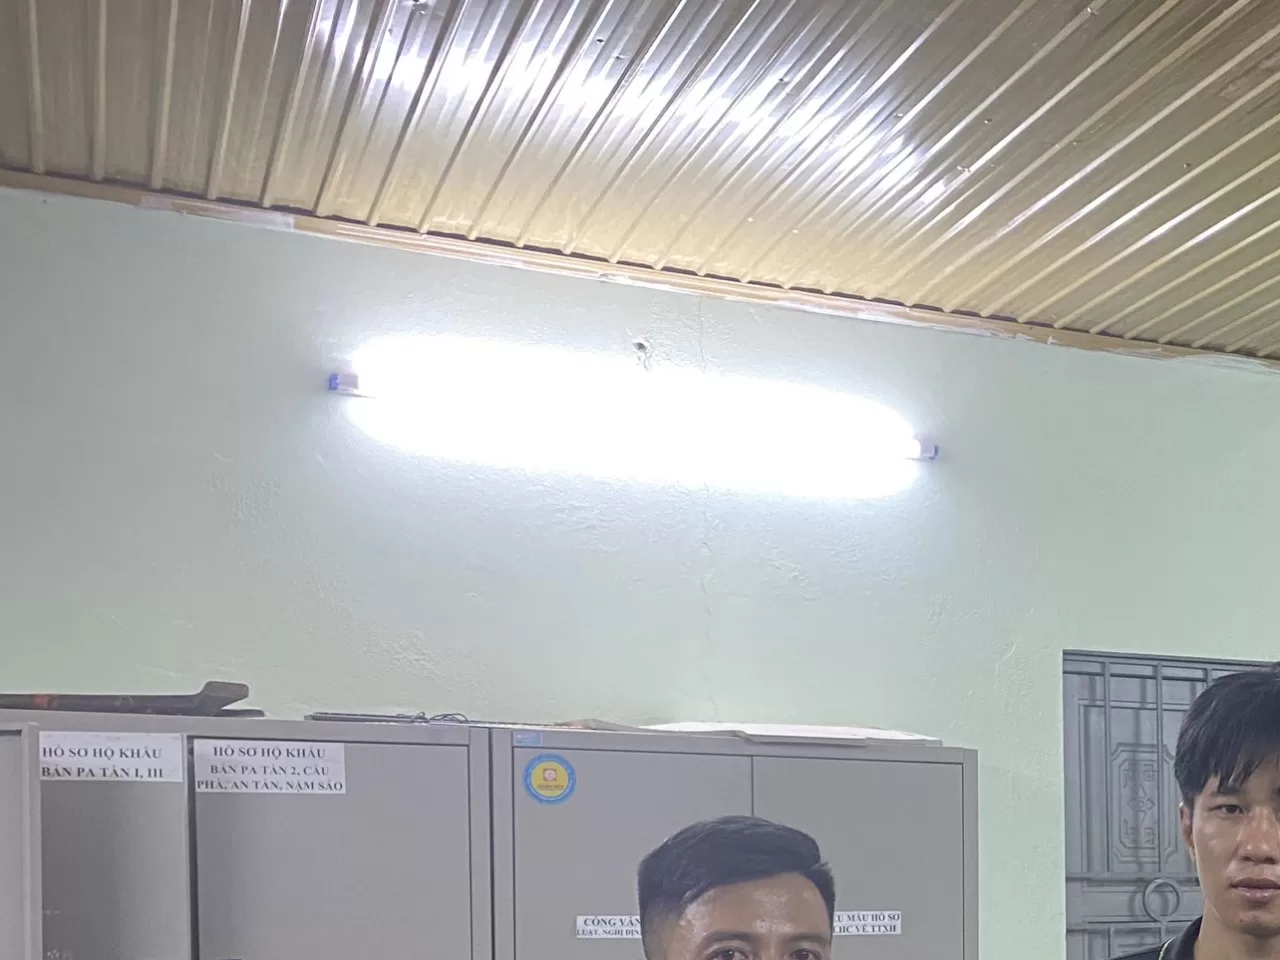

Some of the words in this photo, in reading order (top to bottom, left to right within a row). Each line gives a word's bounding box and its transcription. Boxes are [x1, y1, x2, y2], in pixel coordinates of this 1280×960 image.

[77, 767, 95, 777] PA
[241, 765, 258, 775] PA
[231, 780, 249, 790] AN
[583, 916, 616, 927] CÔNG
